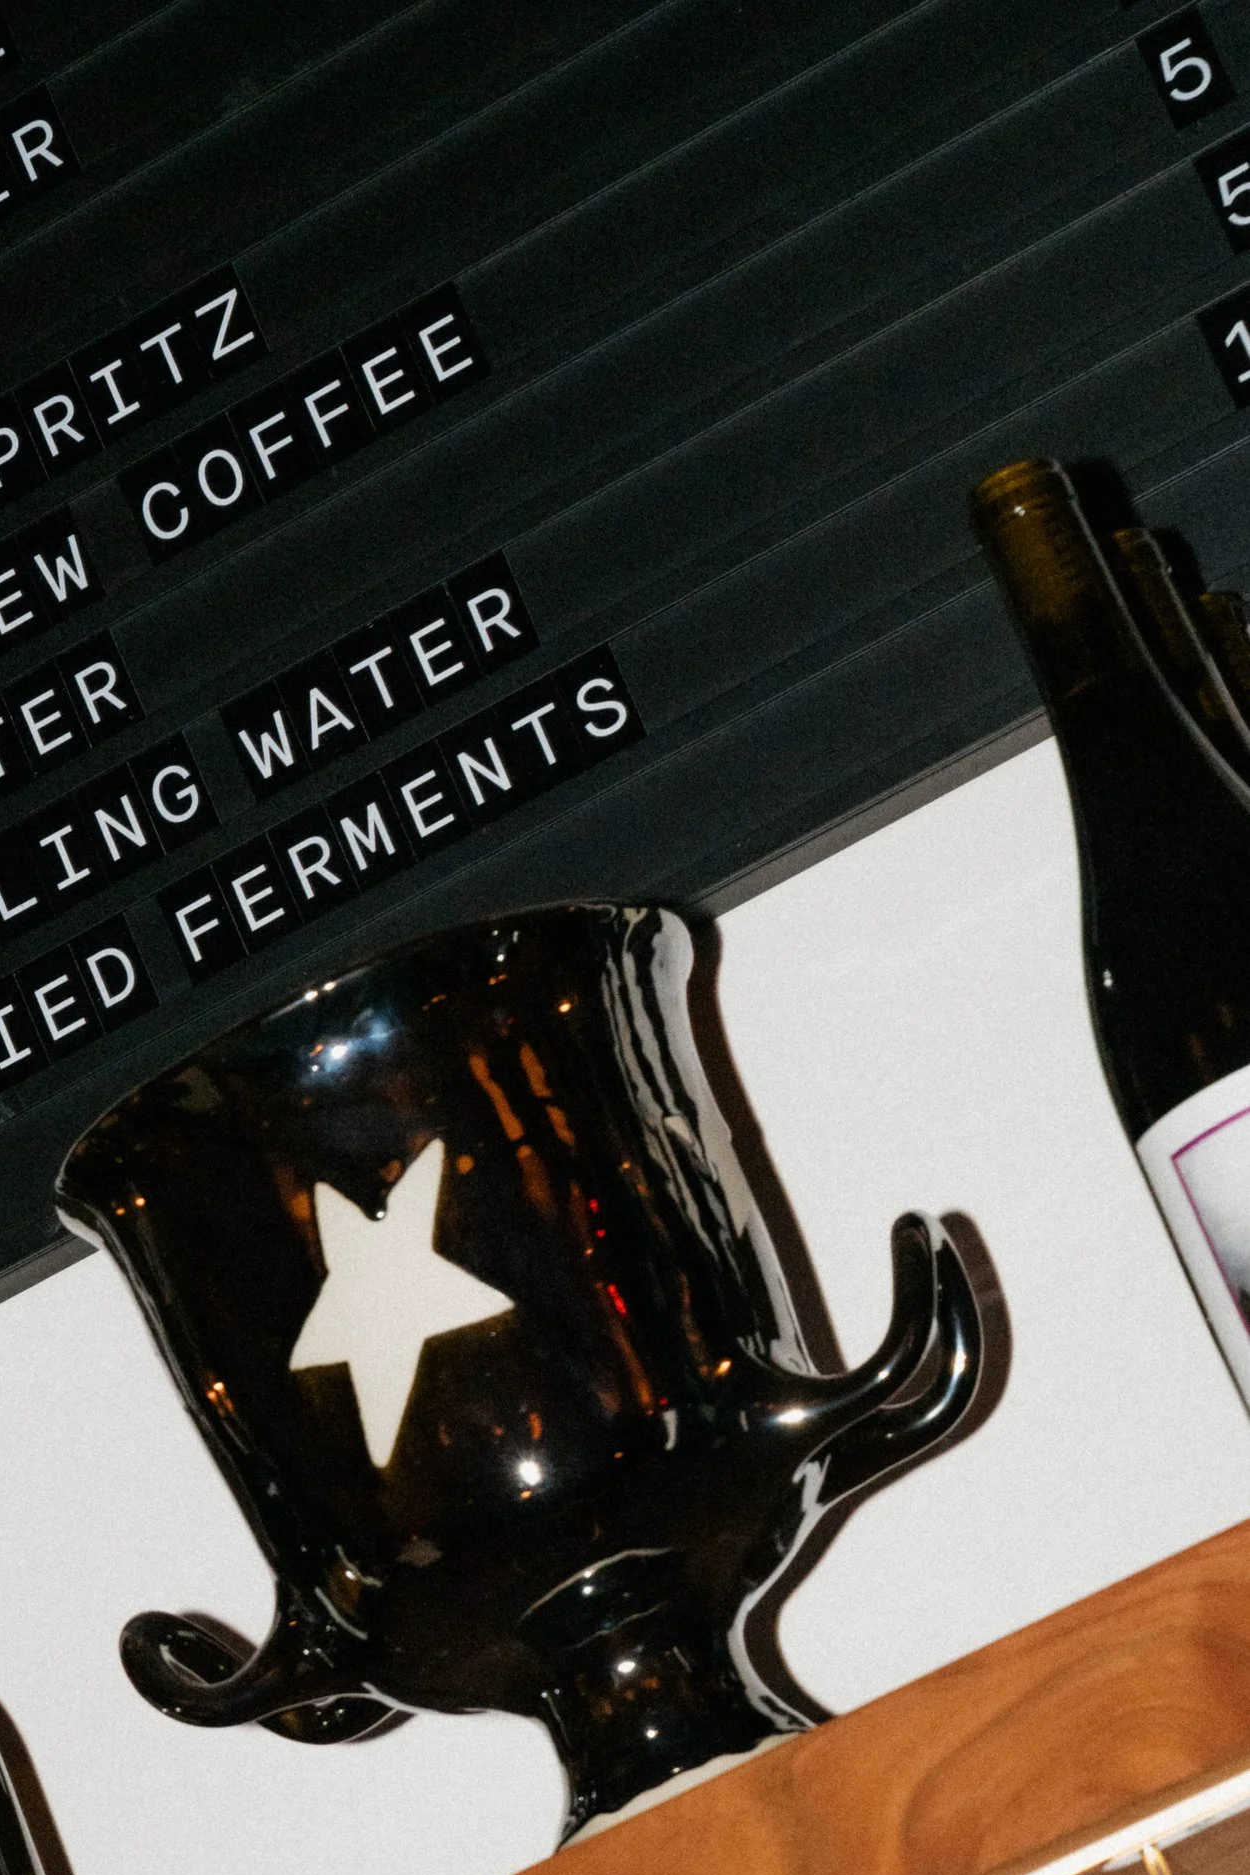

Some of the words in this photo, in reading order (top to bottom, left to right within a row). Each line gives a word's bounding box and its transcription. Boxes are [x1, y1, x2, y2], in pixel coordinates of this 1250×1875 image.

[1160, 37, 1212, 101] 5
[1218, 161, 1250, 226] 5
[141, 313, 474, 540] COFFEE
[237, 586, 522, 780] WATER
[174, 677, 628, 963] FERMENTS
